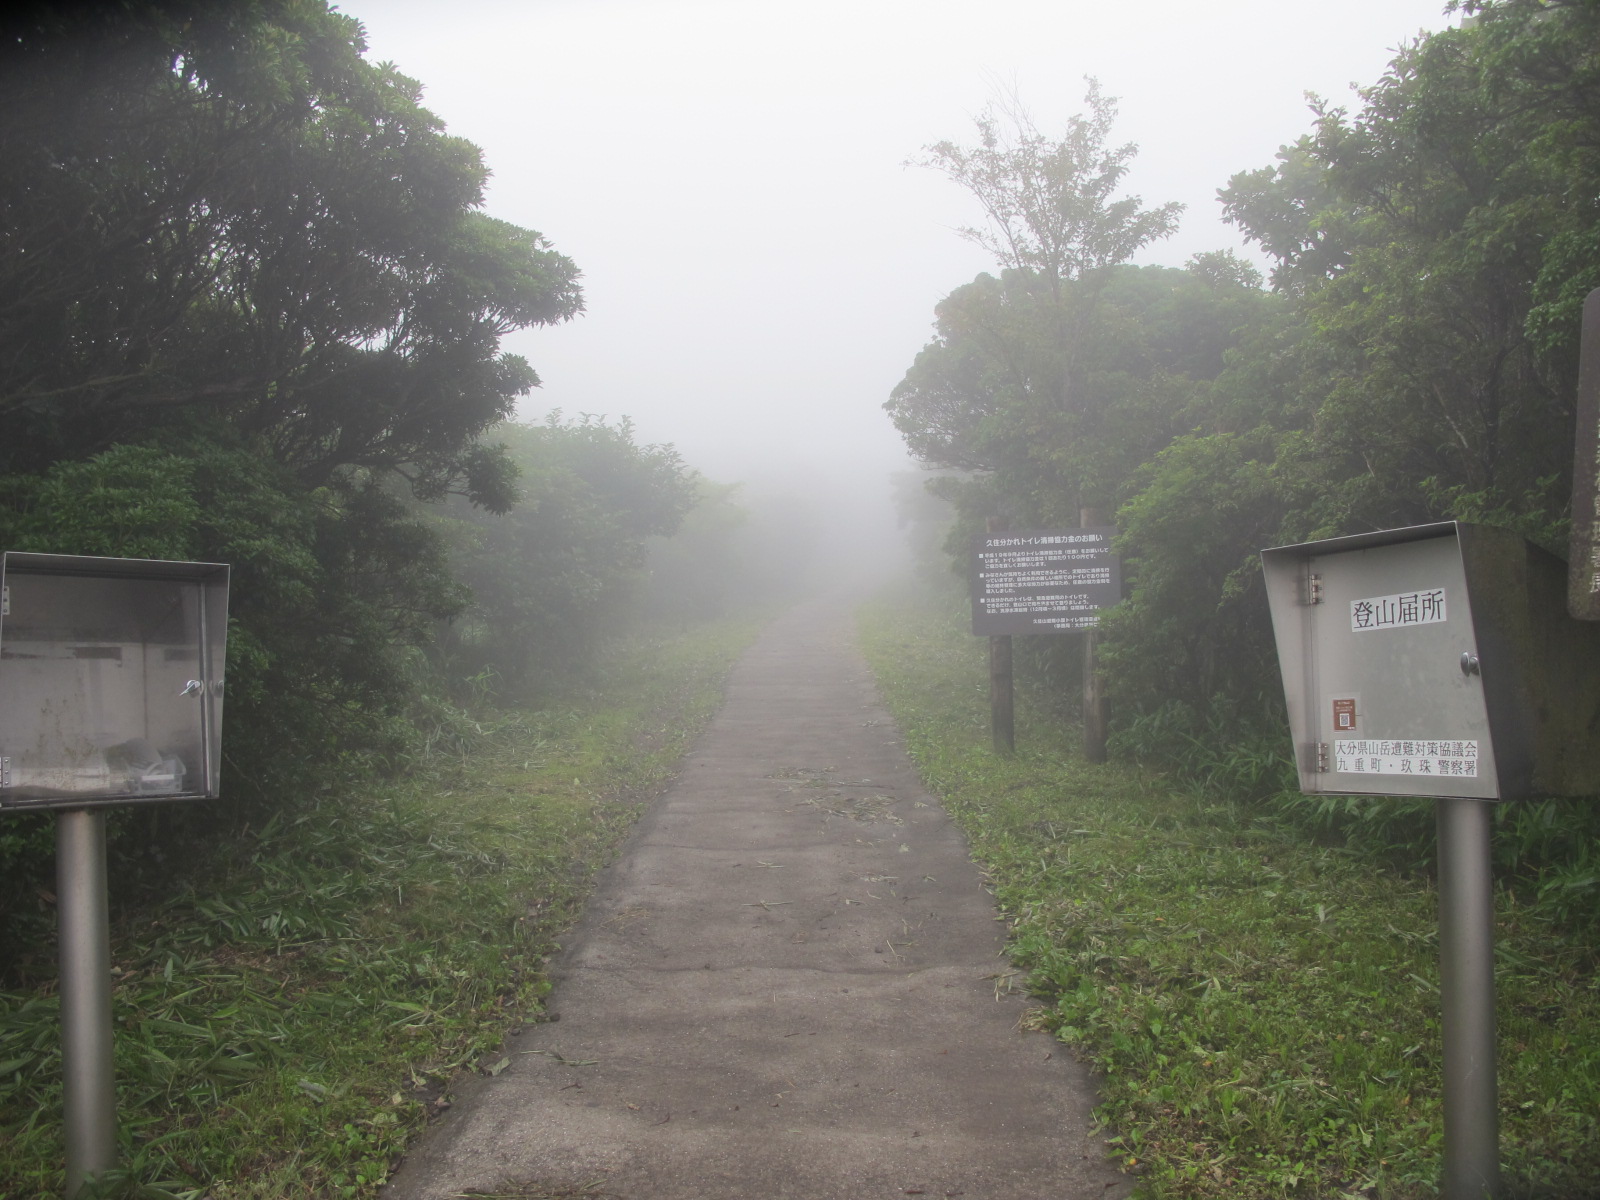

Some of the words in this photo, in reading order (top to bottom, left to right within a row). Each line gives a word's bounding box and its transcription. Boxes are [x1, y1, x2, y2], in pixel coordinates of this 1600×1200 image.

[1353, 590, 1444, 629] 登山届所
[1336, 741, 1476, 758] 大分県山岳遭難対策協議会
[1337, 757, 1476, 775] 九重町・玖珠警察署
